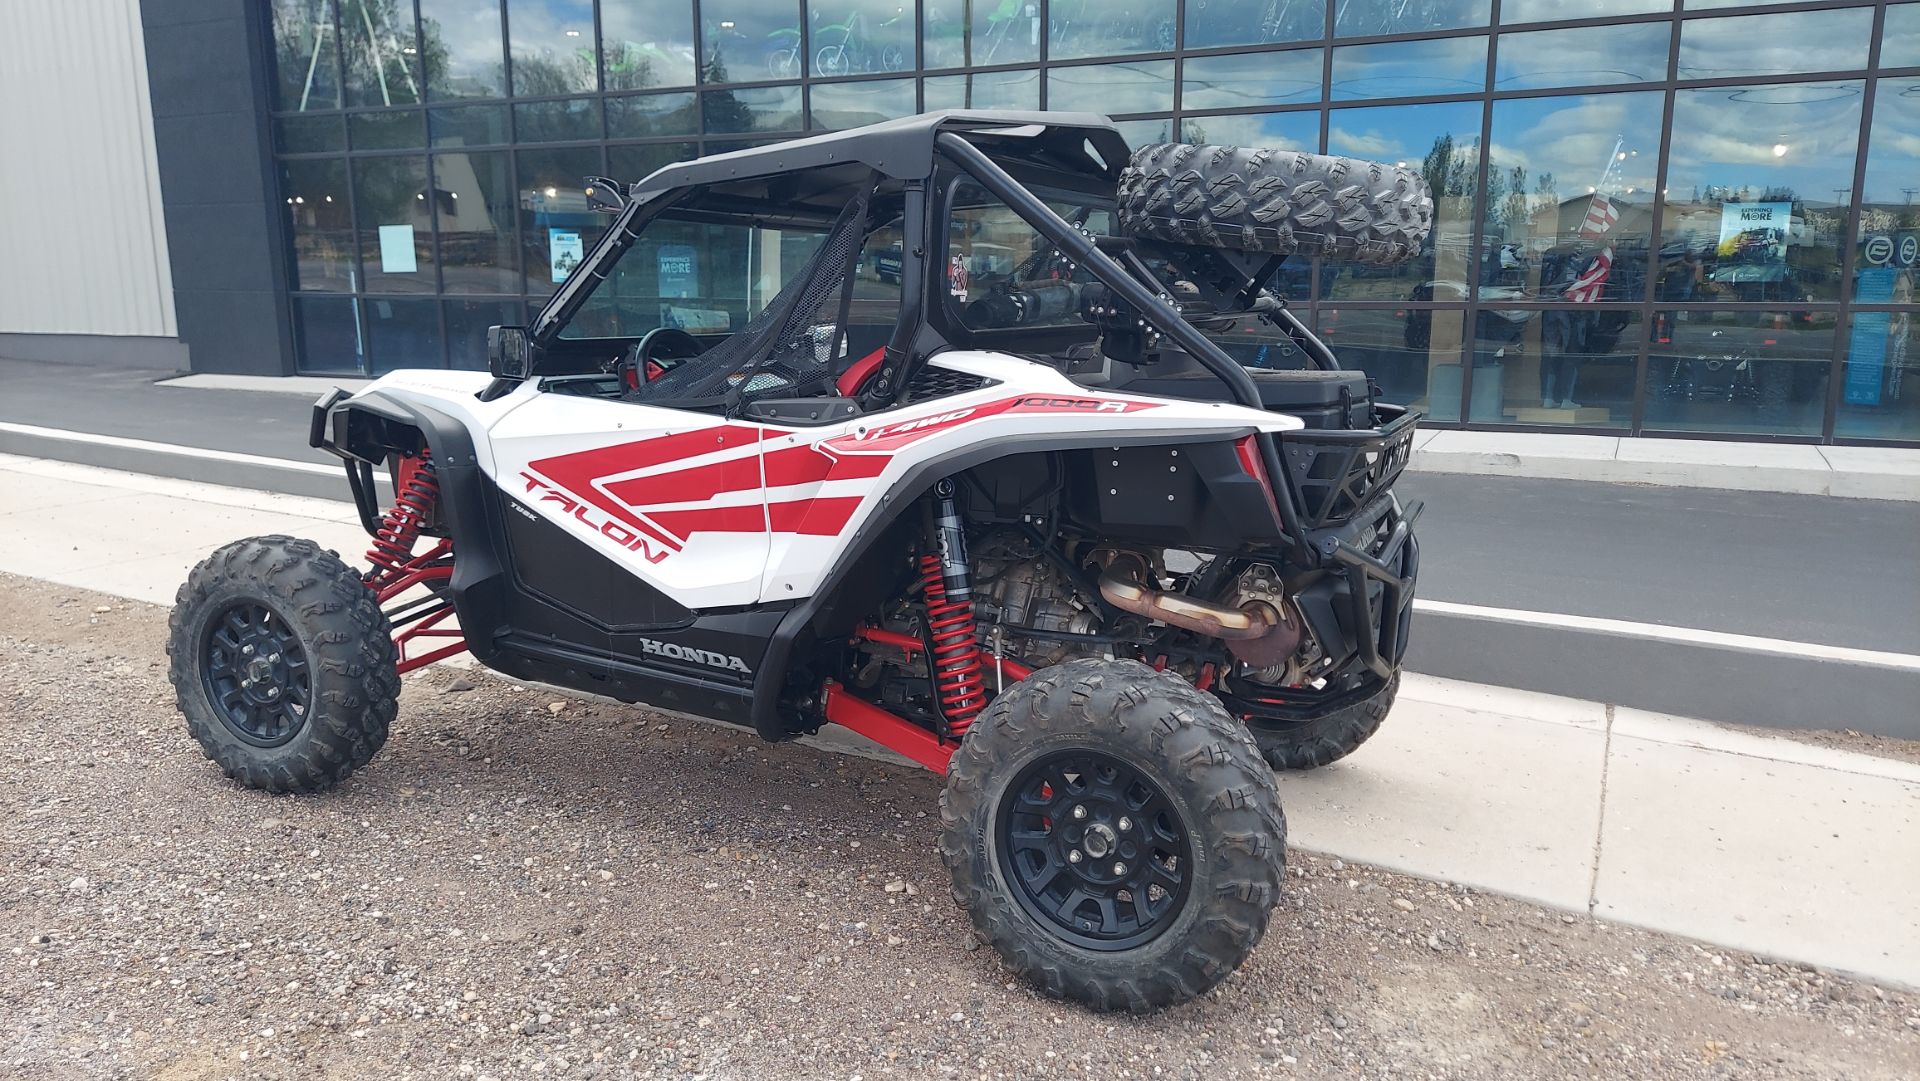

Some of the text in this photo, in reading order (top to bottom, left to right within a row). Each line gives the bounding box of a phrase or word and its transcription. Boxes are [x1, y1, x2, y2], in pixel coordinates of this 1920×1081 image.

[1012, 397, 1127, 413] 1000R
[519, 471, 669, 564] TALON
[640, 638, 752, 674] HONDA
